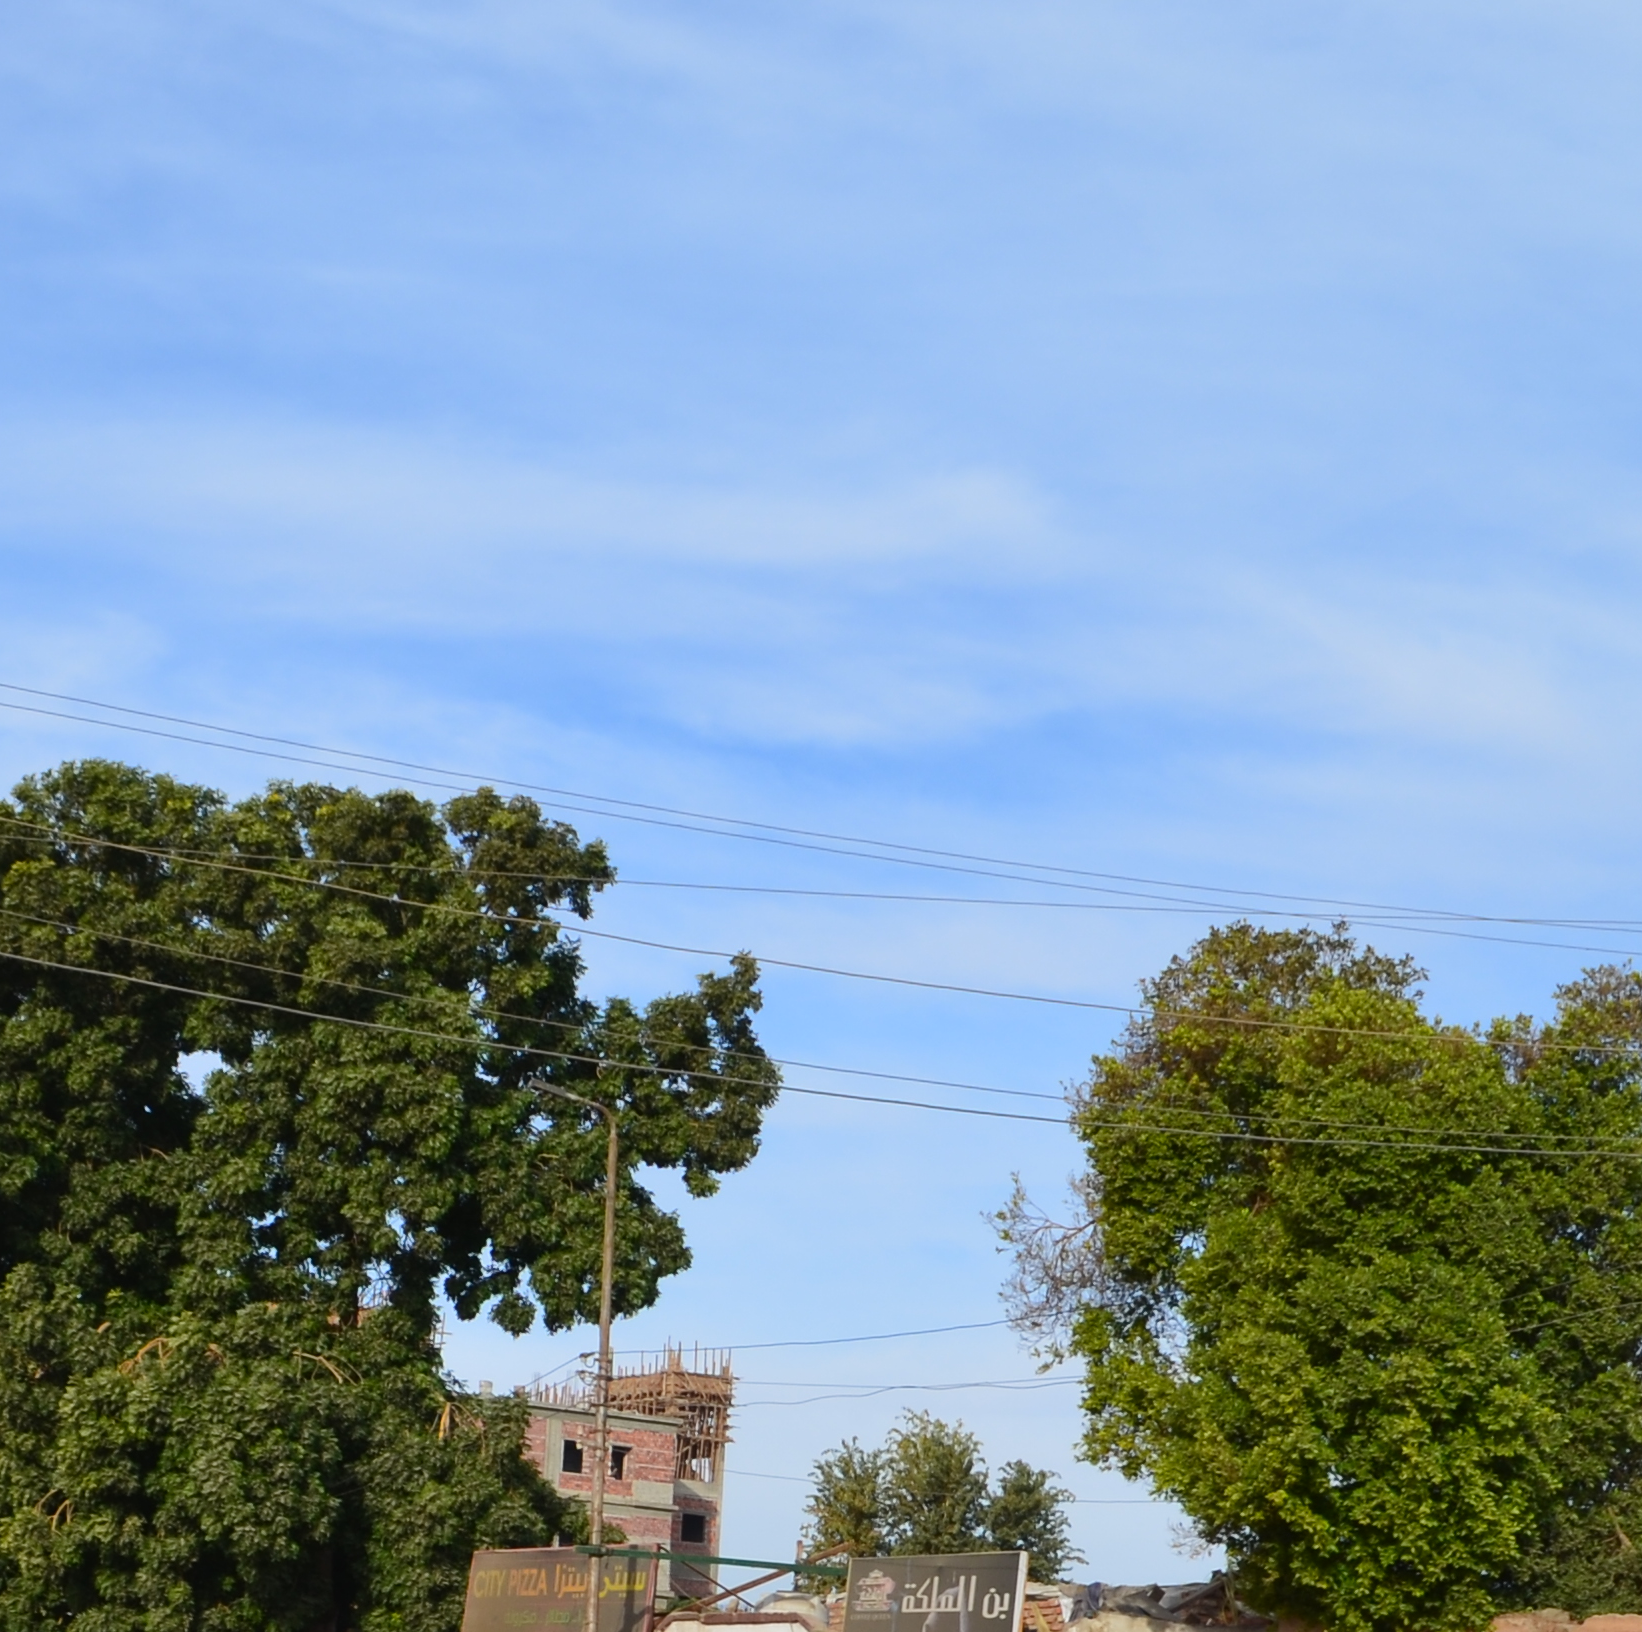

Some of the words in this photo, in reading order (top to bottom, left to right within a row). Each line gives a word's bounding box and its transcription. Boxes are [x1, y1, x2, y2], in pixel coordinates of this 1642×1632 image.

[473, 1568, 508, 1598] CITY
[508, 1568, 548, 1597] PIZZA
[901, 1574, 977, 1614] الملكة
[981, 1587, 1011, 1620] بن
